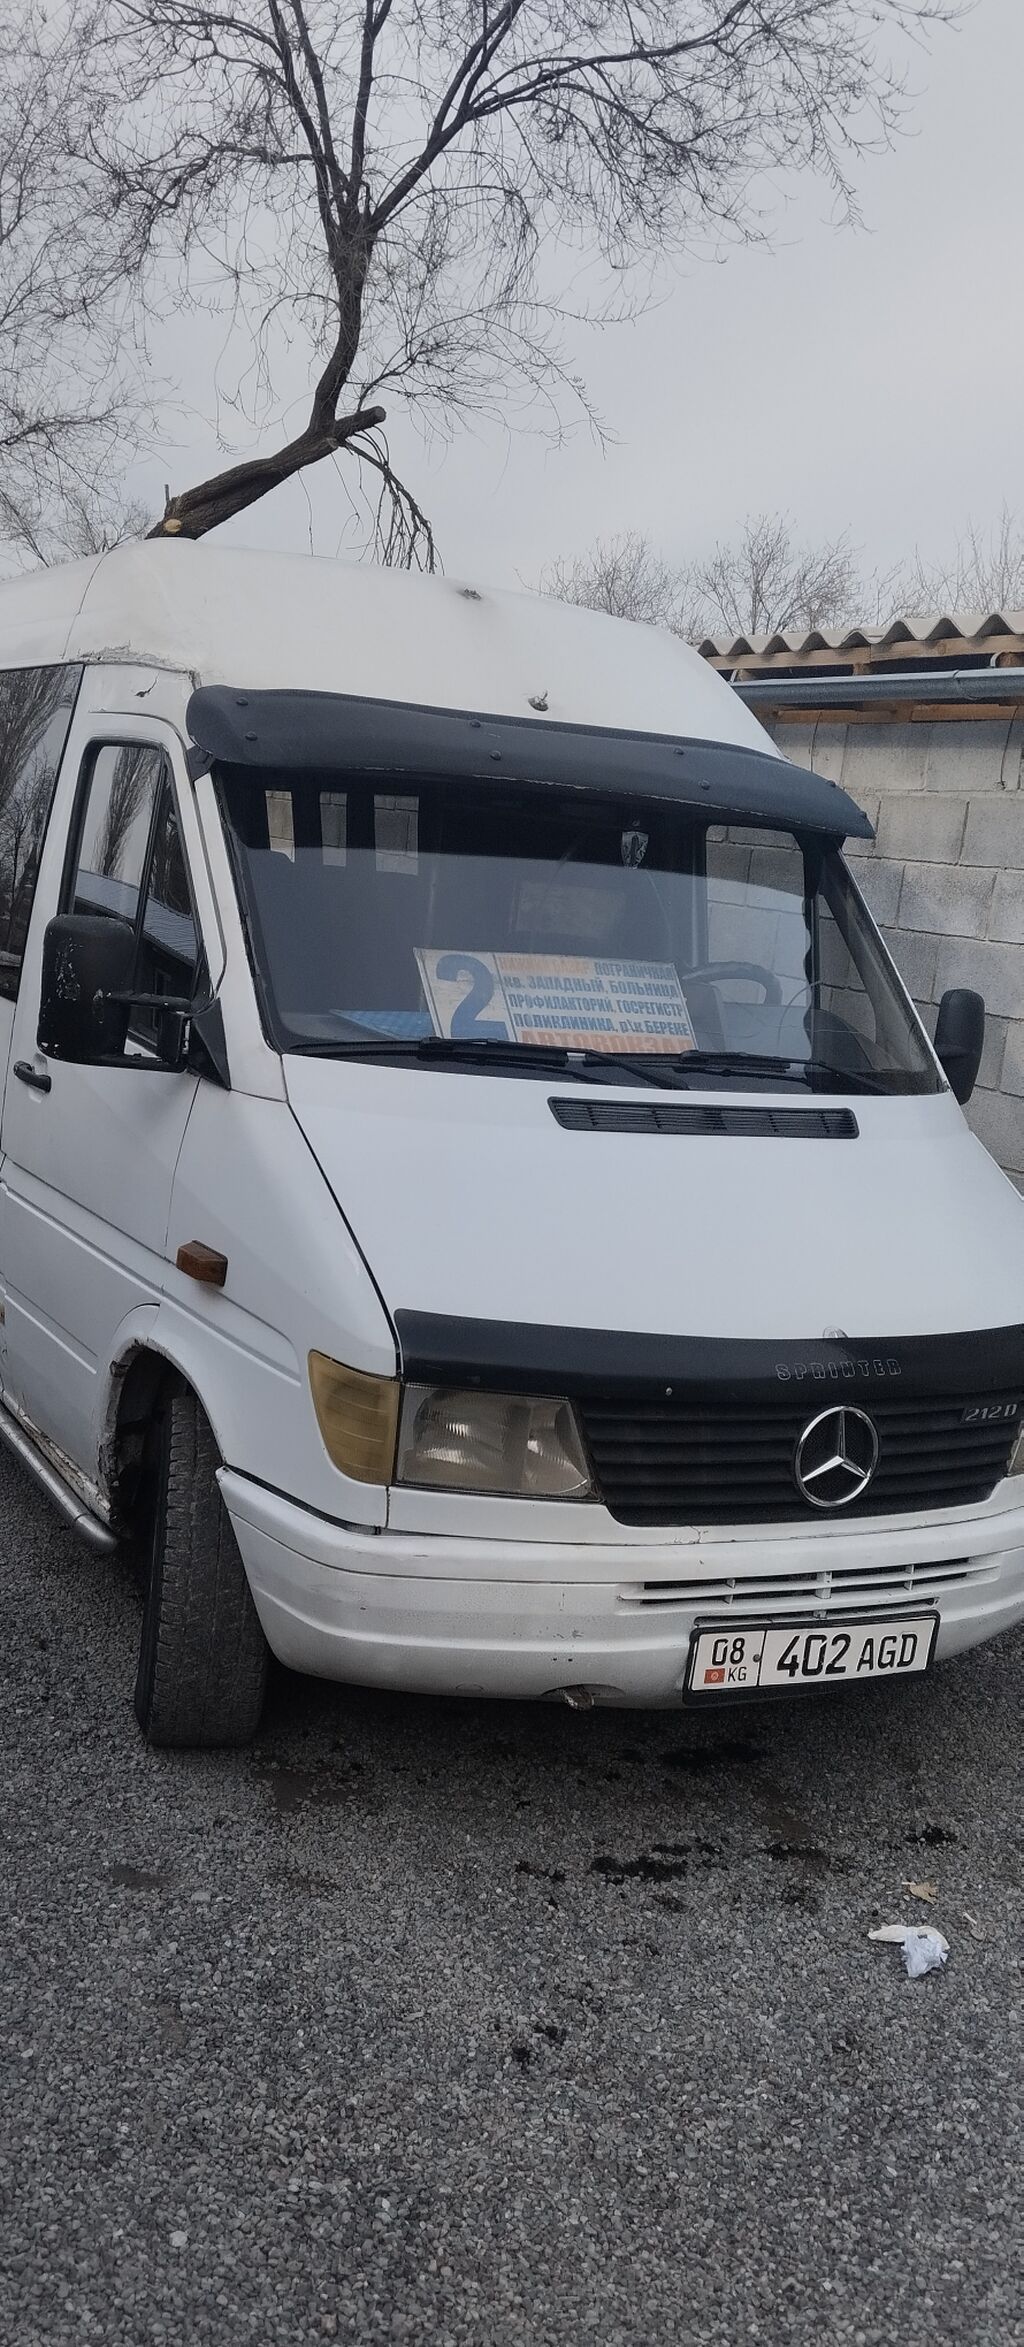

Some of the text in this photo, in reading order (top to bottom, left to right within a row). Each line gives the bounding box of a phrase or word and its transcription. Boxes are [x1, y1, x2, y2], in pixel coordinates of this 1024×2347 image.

[436, 954, 508, 1040] 2
[609, 980, 679, 999] БОЛЬНИЦА
[775, 1358, 902, 1381] SPRINTER
[711, 1633, 919, 1678] 08 402 AGD
[727, 1666, 748, 1682] KG
